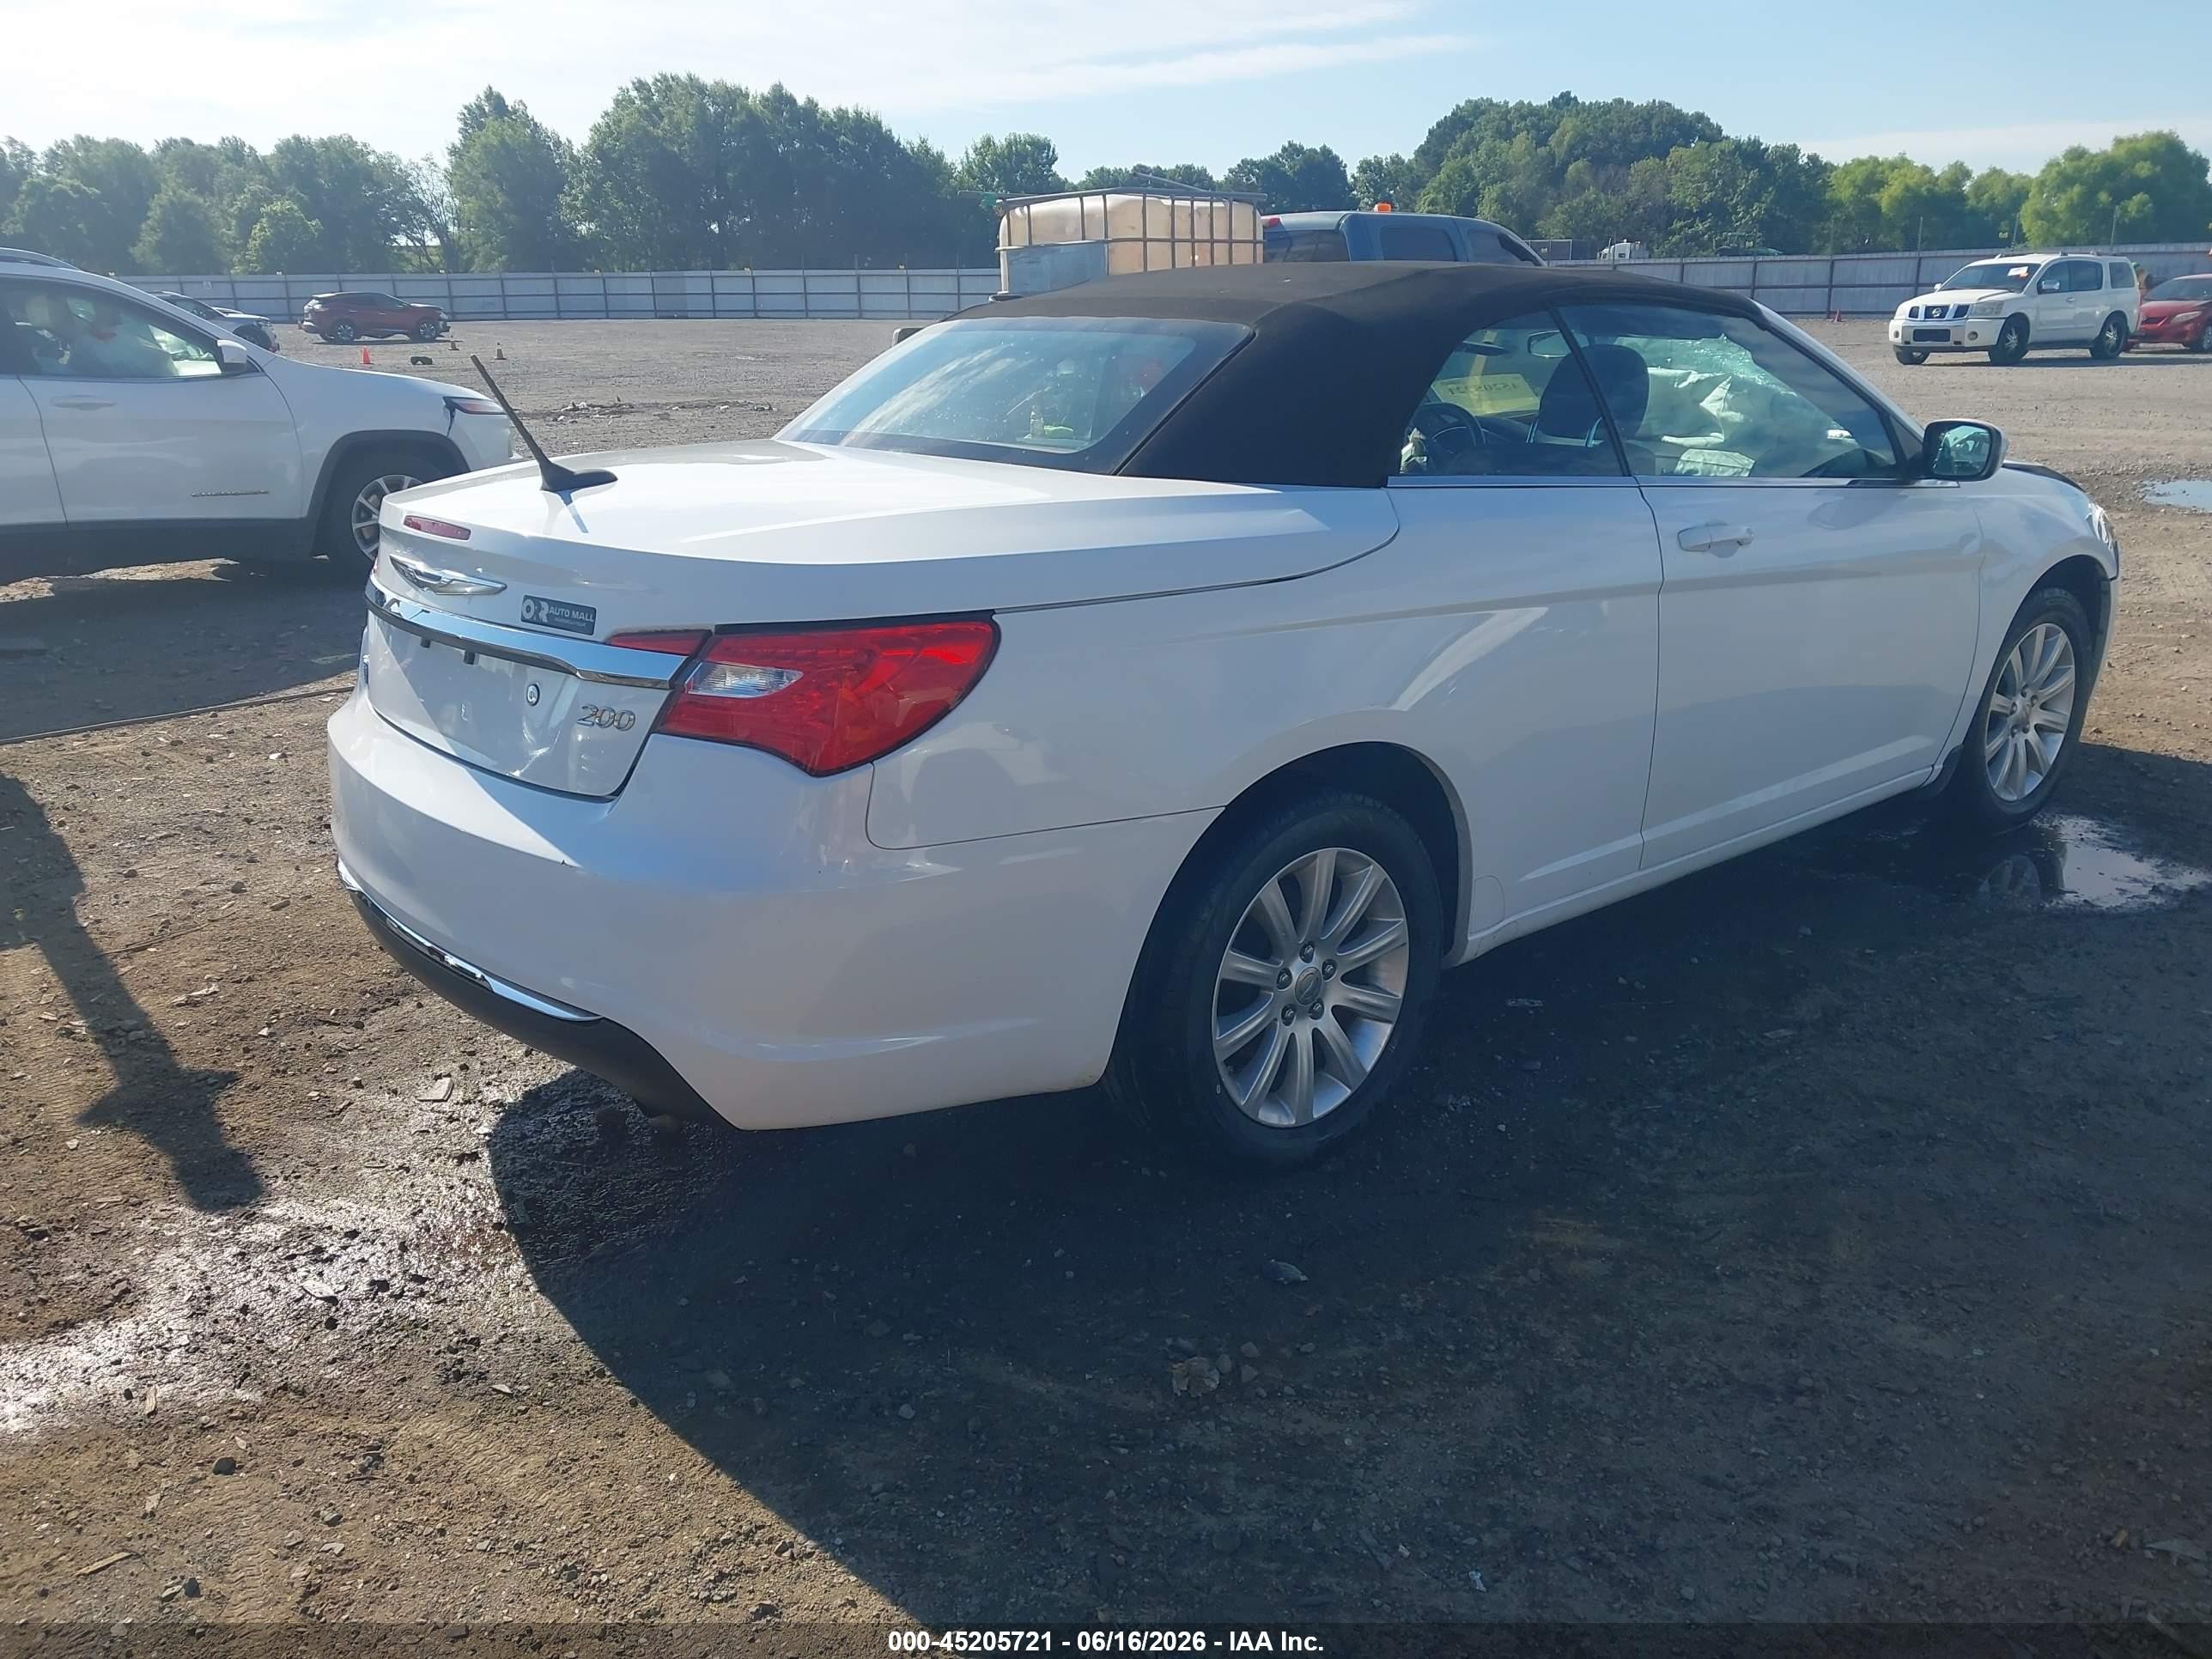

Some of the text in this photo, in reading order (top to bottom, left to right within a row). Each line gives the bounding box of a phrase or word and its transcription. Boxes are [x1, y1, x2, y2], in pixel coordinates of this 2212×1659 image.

[549, 606, 569, 617] AUTO
[572, 611, 595, 623] MALL
[576, 704, 635, 731] 200
